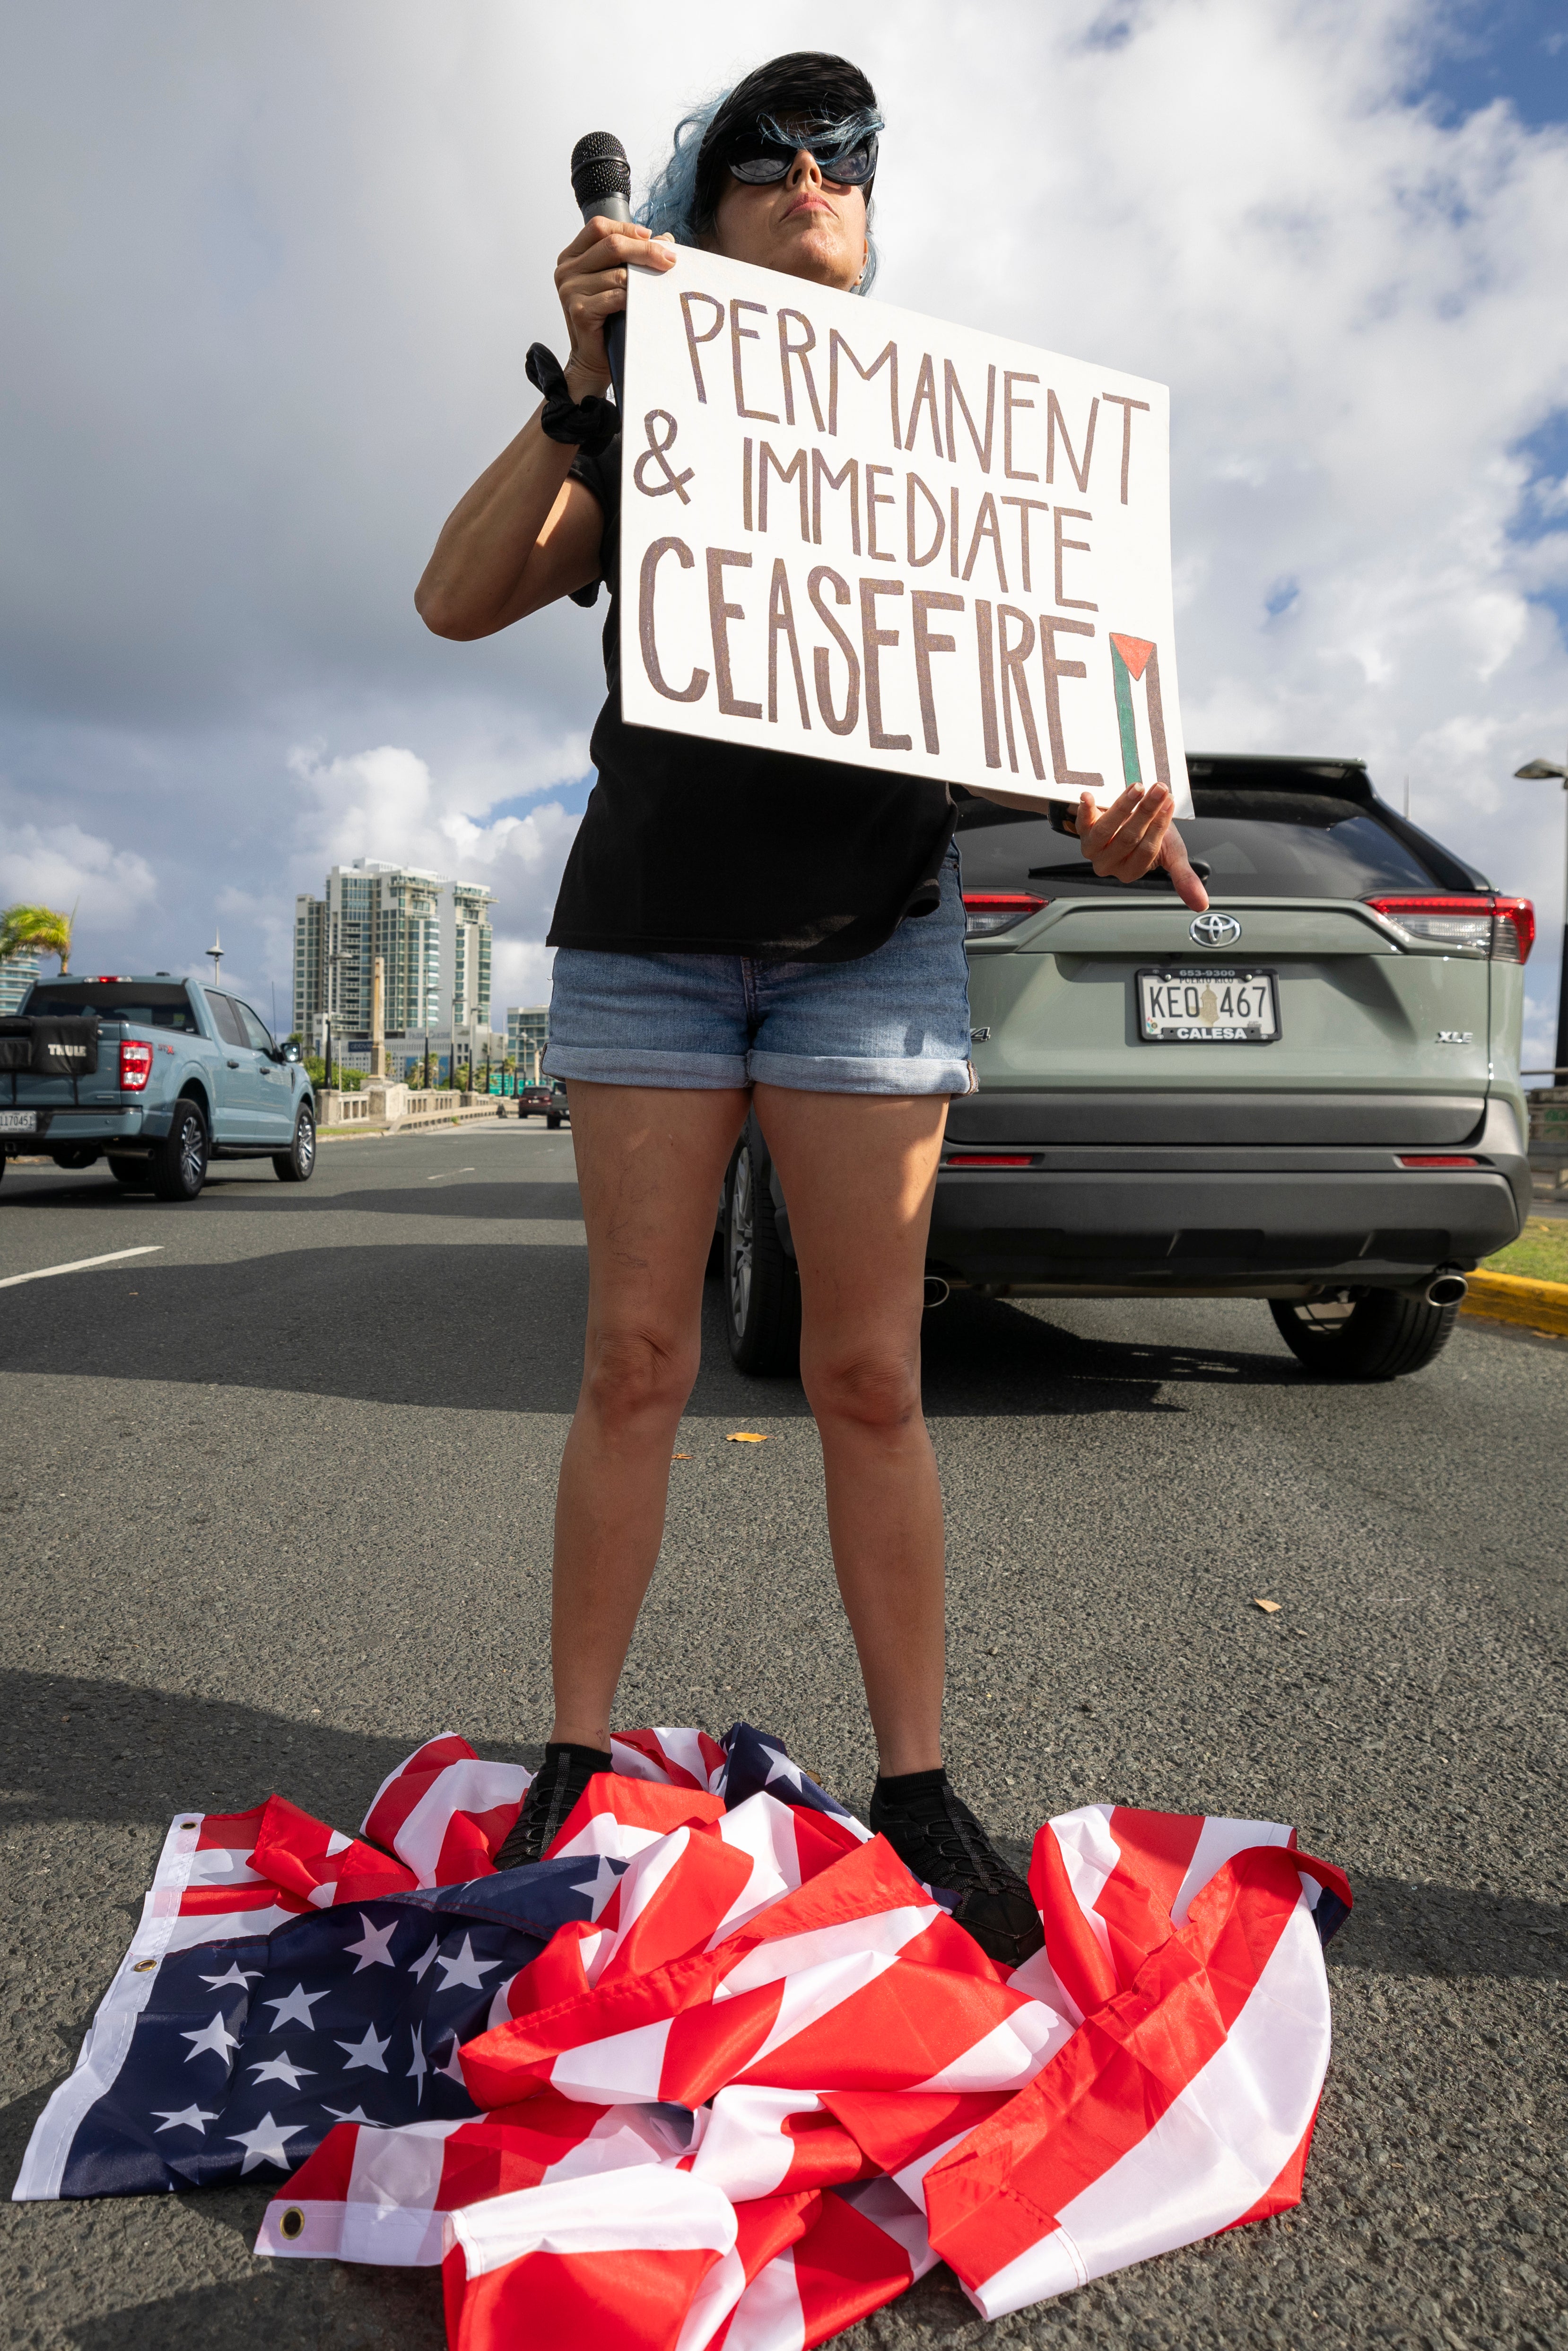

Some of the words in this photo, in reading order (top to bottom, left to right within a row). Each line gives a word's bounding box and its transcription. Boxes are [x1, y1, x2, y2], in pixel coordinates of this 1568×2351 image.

[679, 291, 1150, 505] PERMANENT
[633, 409, 695, 505] &
[743, 436, 1099, 612] IMMEDIATE
[638, 536, 1105, 787] CEASEFIRE
[1220, 986, 1266, 1018] 467
[1177, 1028, 1247, 1039] CALESA
[1437, 1031, 1473, 1043] XLE
[48, 1044, 87, 1057] THULE
